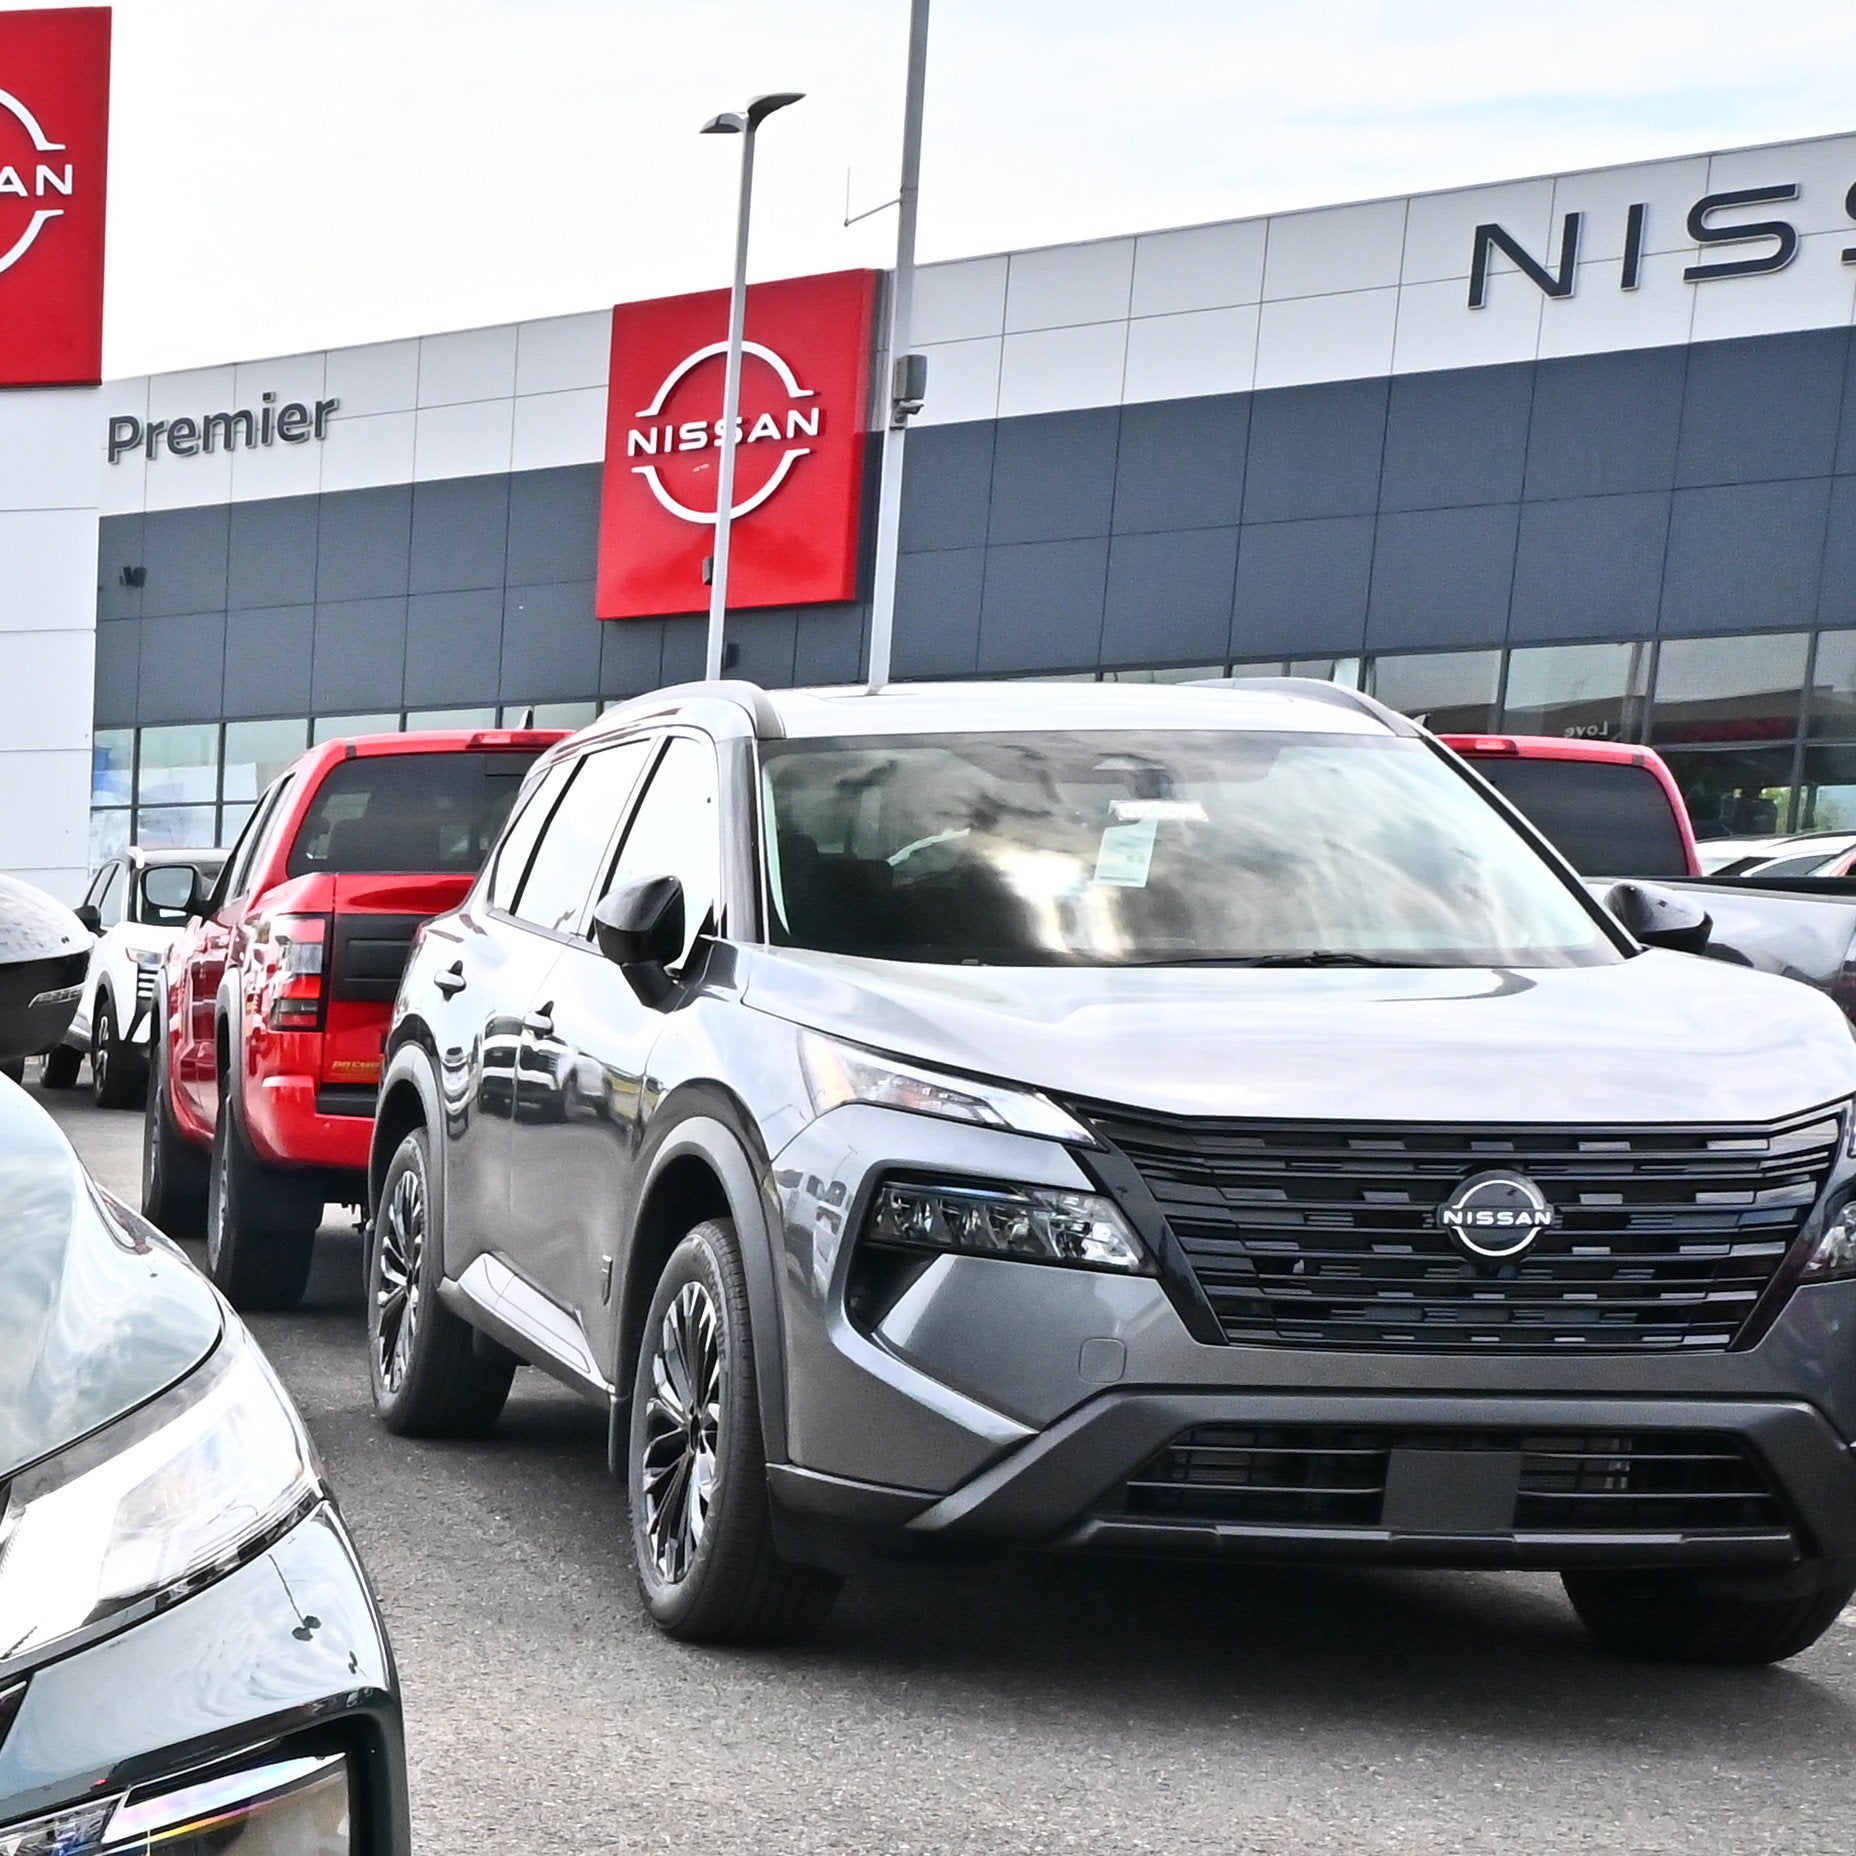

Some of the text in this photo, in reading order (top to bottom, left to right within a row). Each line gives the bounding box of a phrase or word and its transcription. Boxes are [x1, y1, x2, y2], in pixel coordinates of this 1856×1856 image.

[1468, 179, 1856, 310] NIS
[107, 391, 339, 464] Premier
[627, 407, 820, 457] NISSAN
[1443, 1210, 1551, 1226] NISSAN
